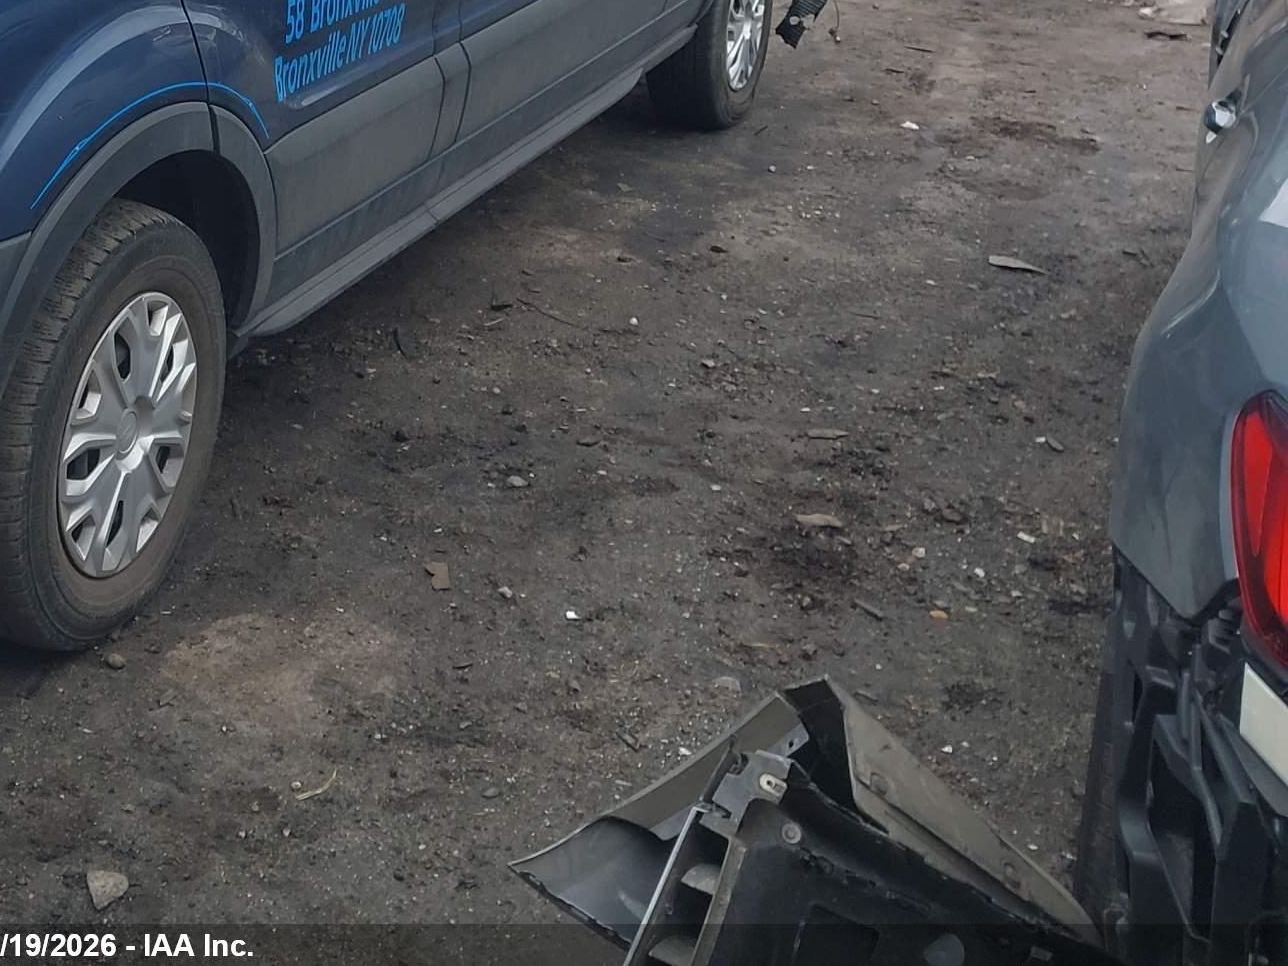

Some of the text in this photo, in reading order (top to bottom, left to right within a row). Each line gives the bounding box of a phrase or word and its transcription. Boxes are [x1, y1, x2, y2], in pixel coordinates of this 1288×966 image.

[274, 2, 406, 103] Bronxville NY 10708
